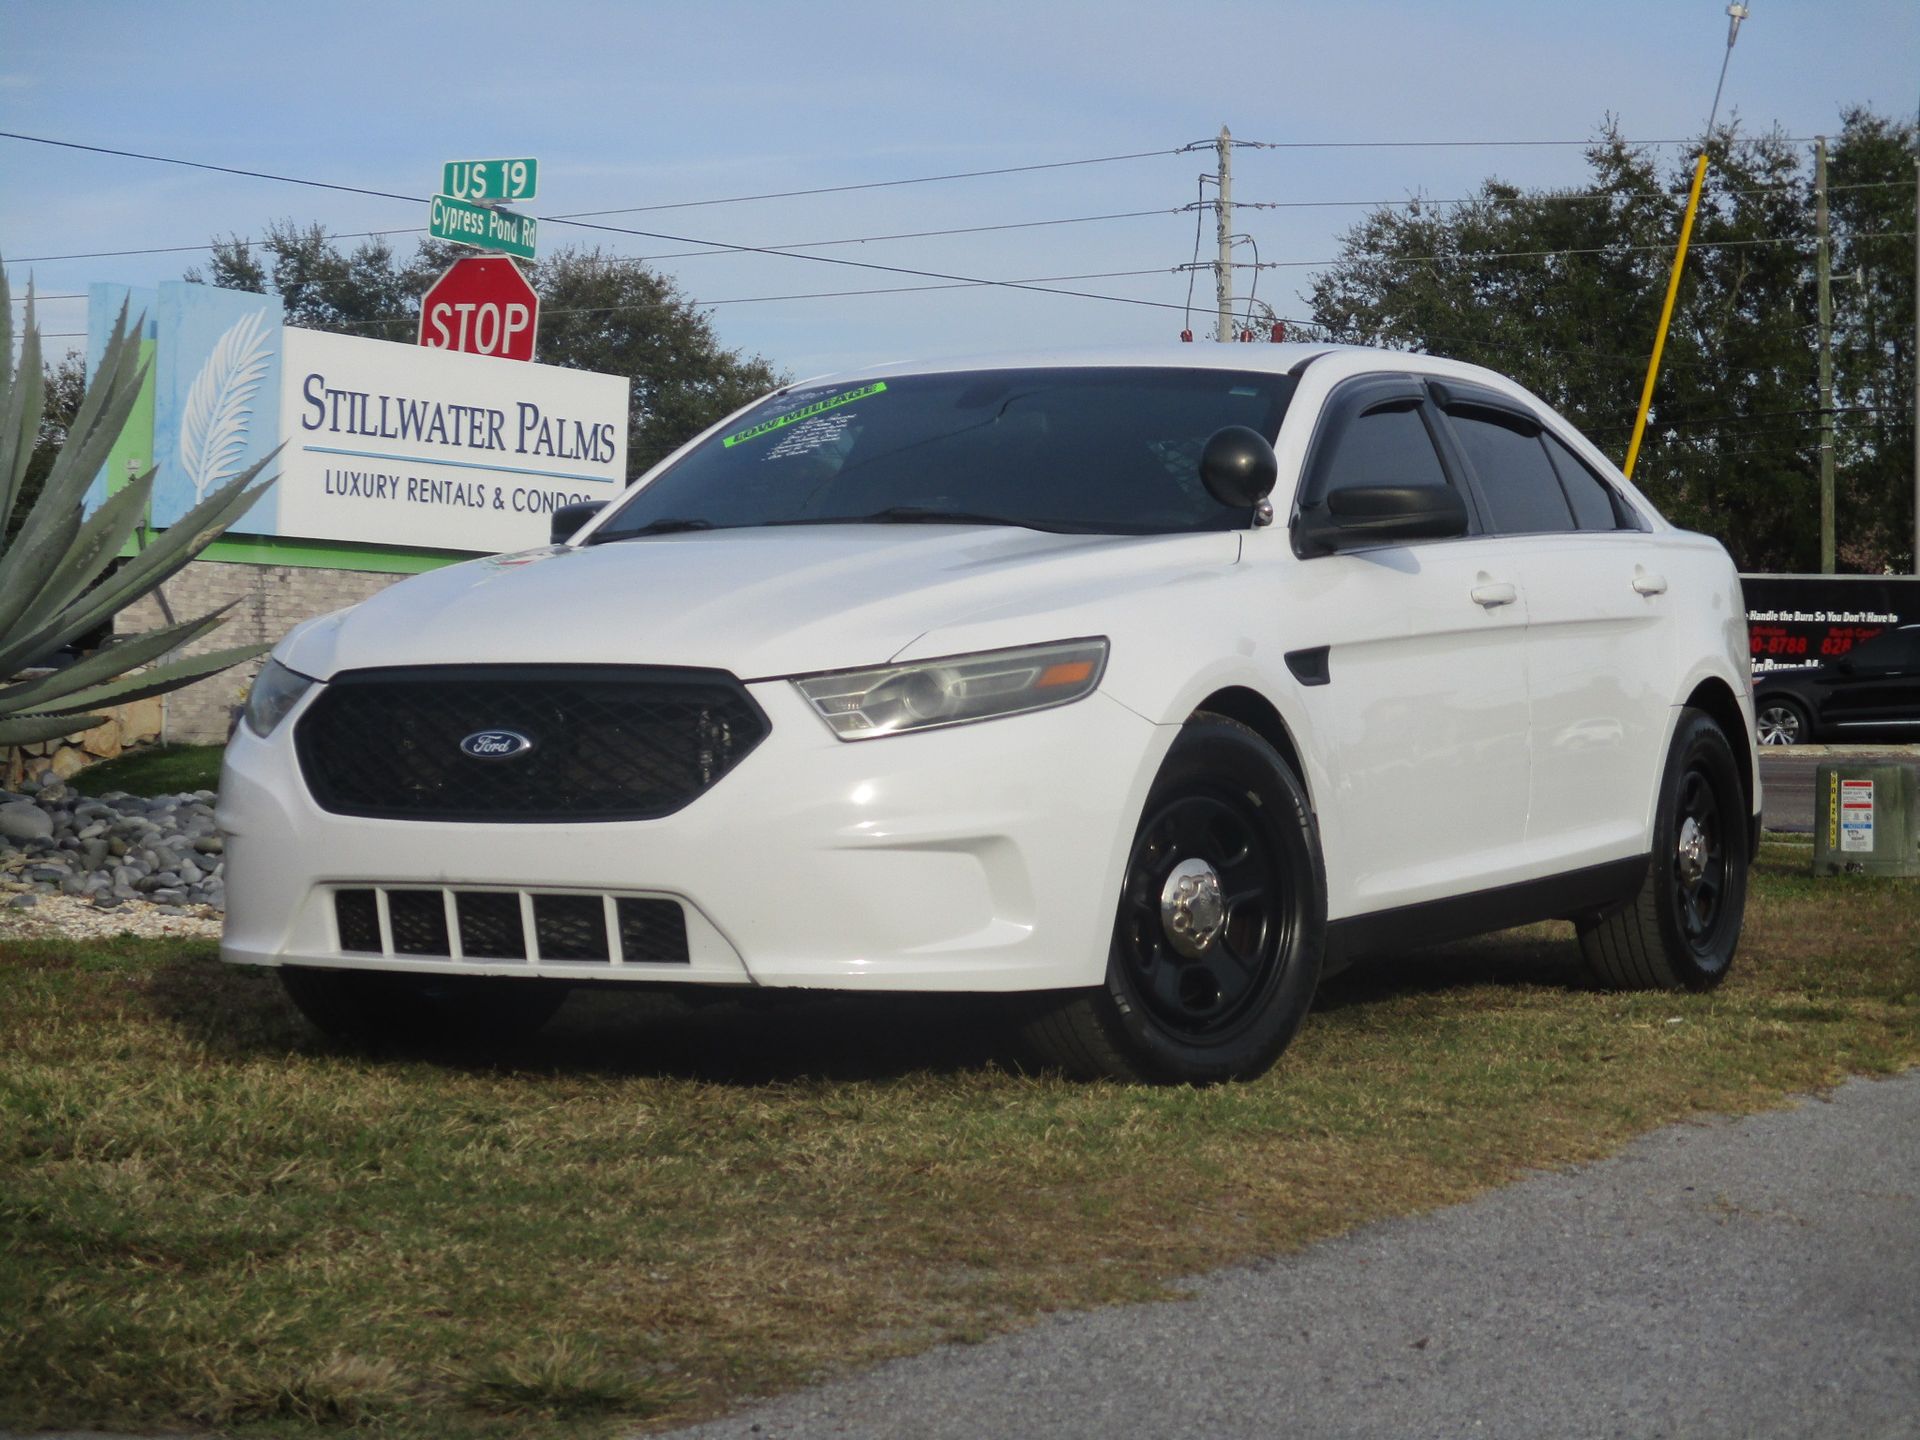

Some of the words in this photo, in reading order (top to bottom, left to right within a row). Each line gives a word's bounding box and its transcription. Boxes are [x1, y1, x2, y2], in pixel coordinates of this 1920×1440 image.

[452, 163, 487, 199] US
[501, 161, 527, 198] 19
[432, 198, 485, 236] Cypress
[488, 210, 518, 244] Pond
[521, 218, 536, 248] Rd
[426, 302, 529, 355] STOP
[301, 373, 507, 451] STILLWATER
[514, 401, 616, 464] PALMS
[325, 468, 400, 500] LUXURY
[407, 477, 486, 510] RENTALS
[493, 486, 505, 510] &
[512, 487, 591, 514] COND
[1749, 610, 1778, 622] Handle
[1779, 611, 1793, 622] the
[1794, 611, 1814, 622] Burn
[1814, 611, 1826, 622] So
[1827, 611, 1842, 622] You
[1843, 611, 1866, 623] Don't
[1866, 612, 1888, 623] Have
[1888, 613, 1899, 623] to
[473, 734, 512, 753] Ford
